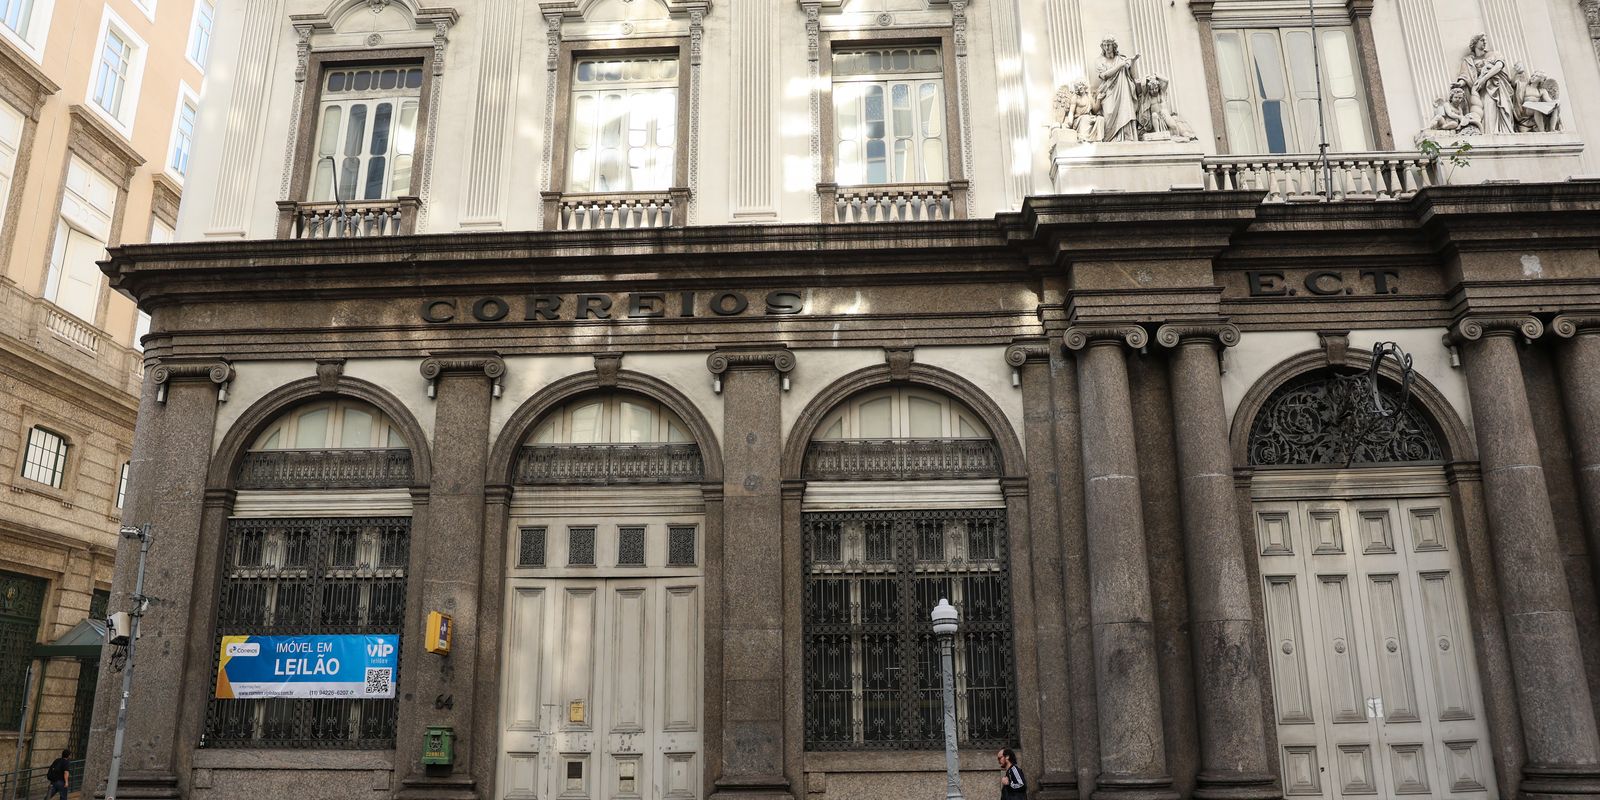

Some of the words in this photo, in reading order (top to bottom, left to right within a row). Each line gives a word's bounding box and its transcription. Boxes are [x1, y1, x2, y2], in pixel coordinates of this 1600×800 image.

[1246, 269, 1399, 297] E.C.T.
[421, 289, 803, 323] CORREIOS
[276, 641, 313, 653] IMÓVEL
[317, 642, 333, 653] EM
[274, 654, 340, 675] LEILÃO
[435, 694, 454, 710] 64
